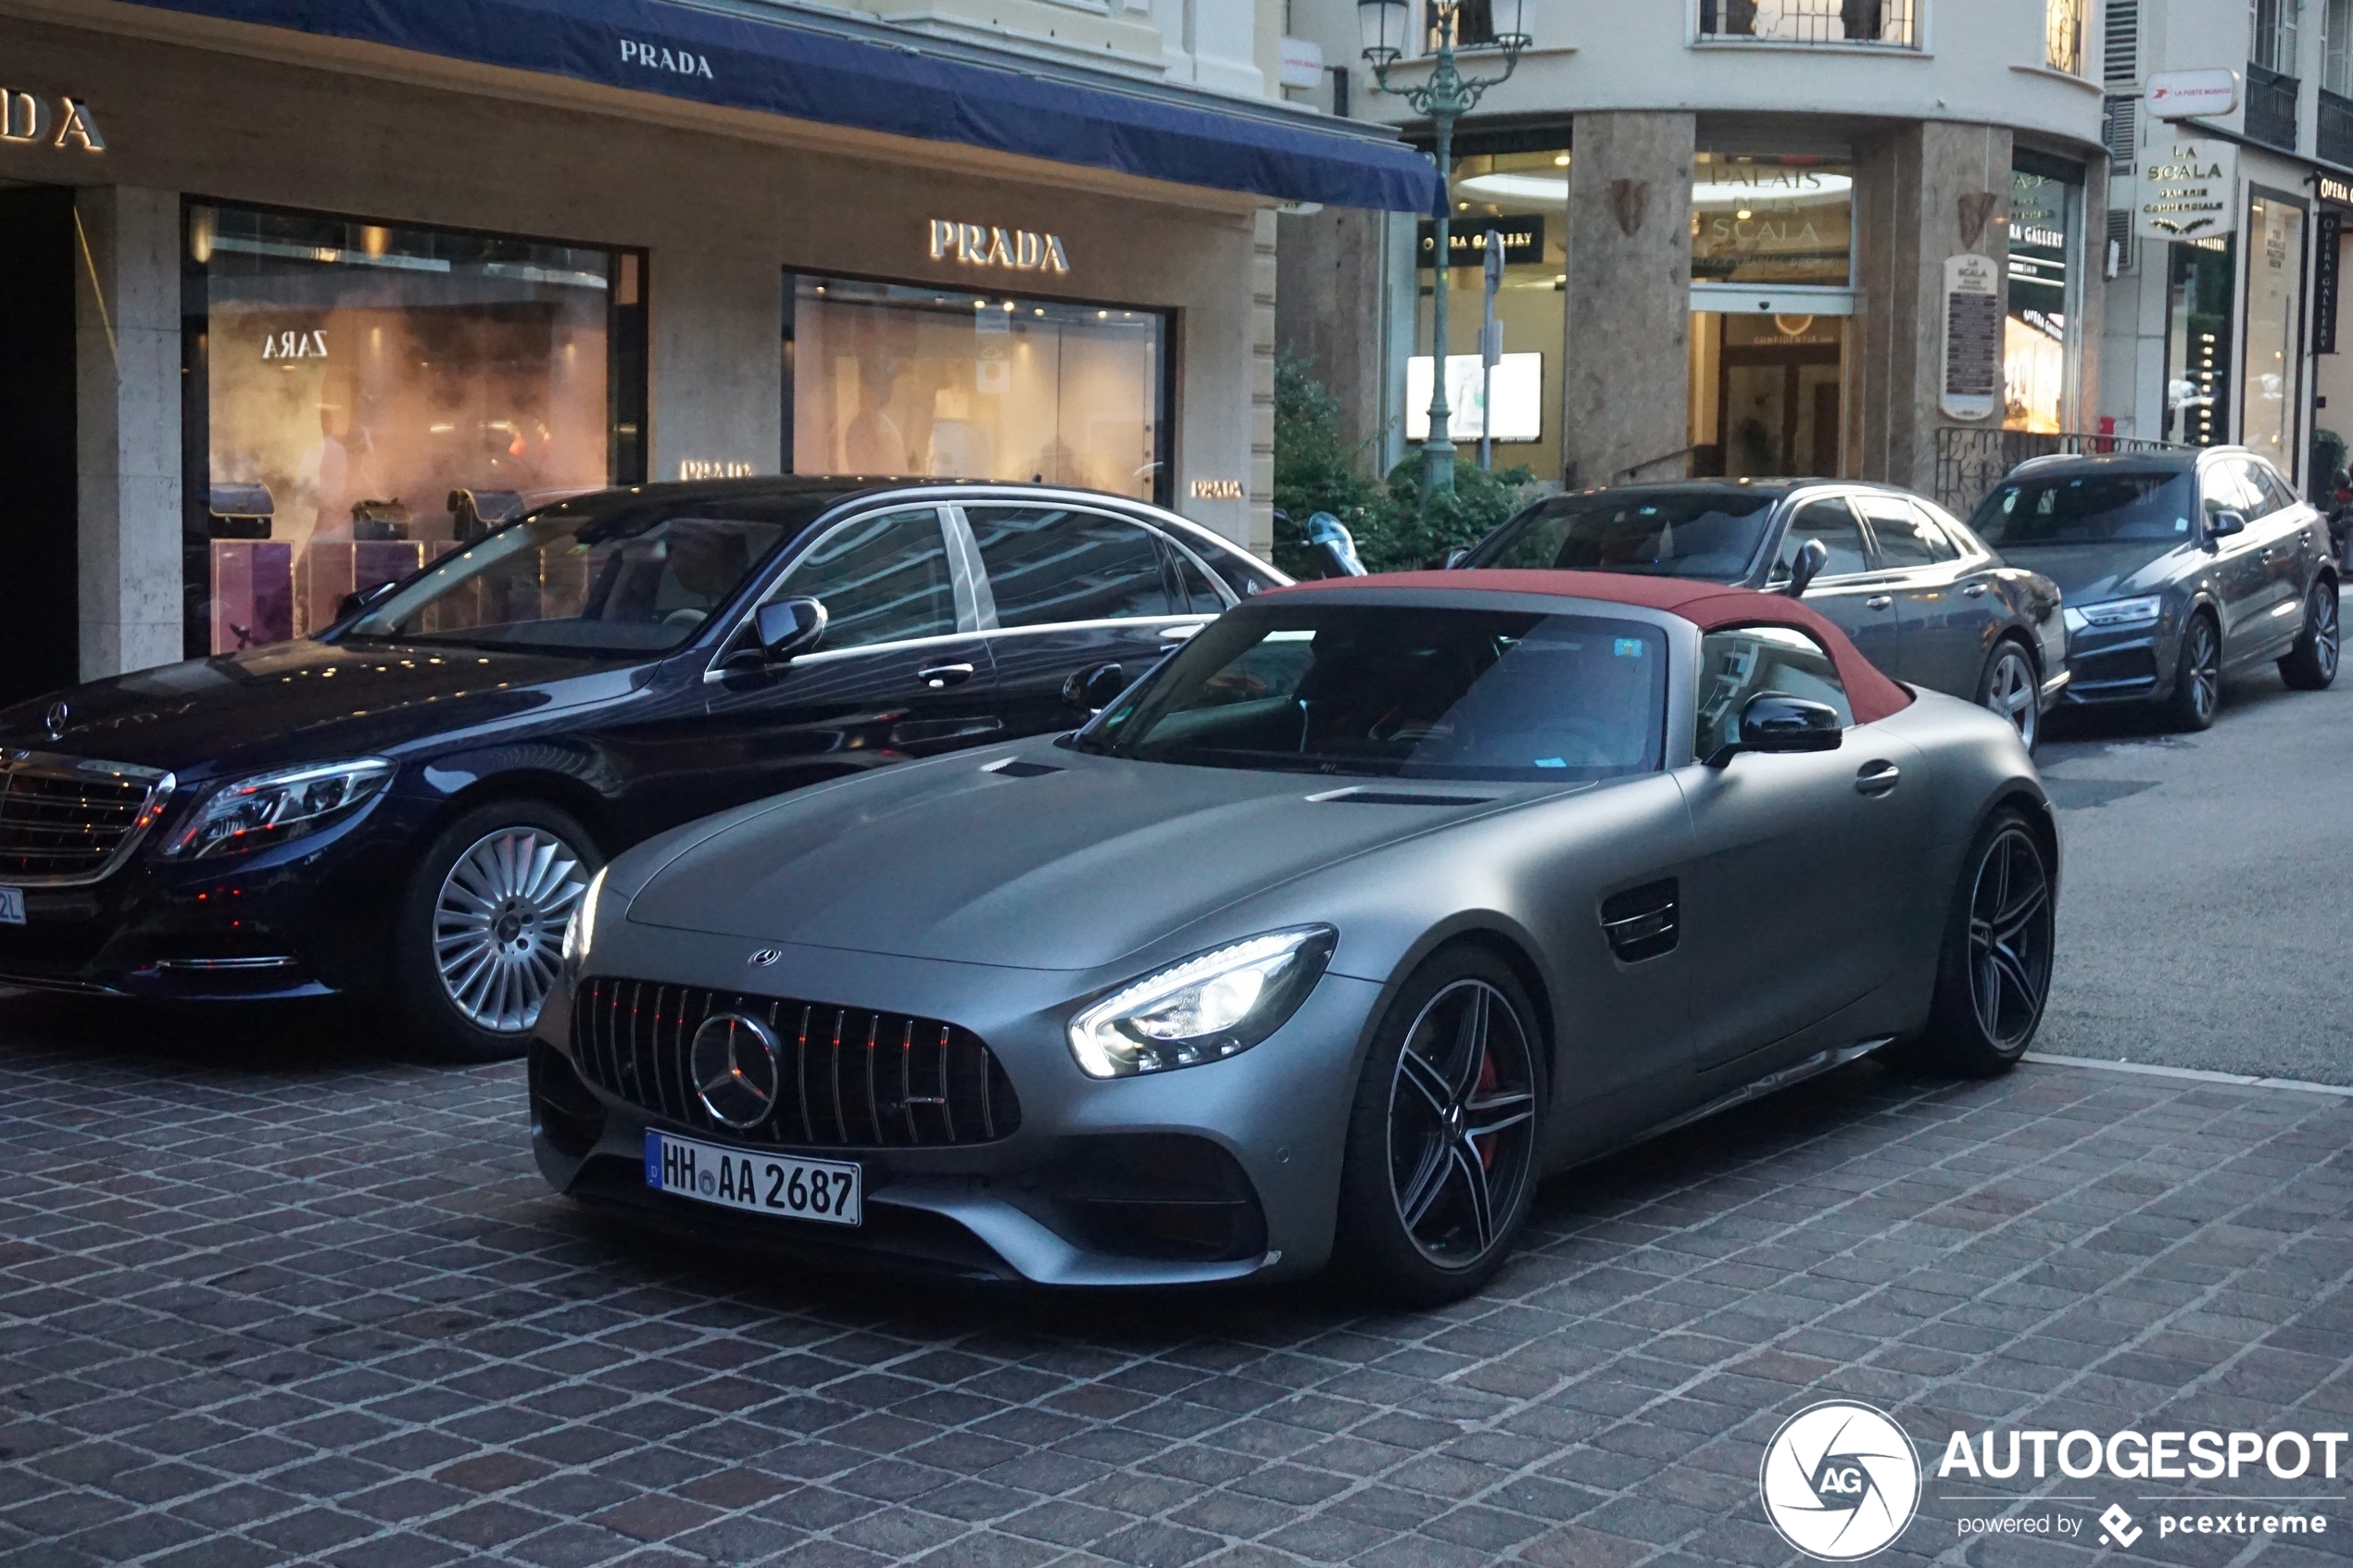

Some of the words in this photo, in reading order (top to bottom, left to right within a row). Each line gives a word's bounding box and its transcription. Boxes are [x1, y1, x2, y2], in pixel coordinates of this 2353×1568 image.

[620, 39, 714, 80] PRADA
[0, 87, 107, 151] DA
[2173, 144, 2197, 159] LA
[1711, 168, 1822, 189] PALAIS
[2148, 163, 2223, 181] SCALA
[2159, 188, 2208, 198] GALERIE
[2321, 178, 2348, 202] OPERA
[2144, 202, 2223, 213] COMMERCIALE
[1713, 218, 1820, 246] SCALA
[2024, 226, 2064, 248] GALLERY
[930, 219, 1071, 275] PRADA
[1423, 235, 1467, 251] ORA
[1190, 480, 1244, 498] PRADA
[663, 1142, 696, 1191] HH
[719, 1156, 756, 1204] AA
[765, 1163, 853, 1216] 2687
